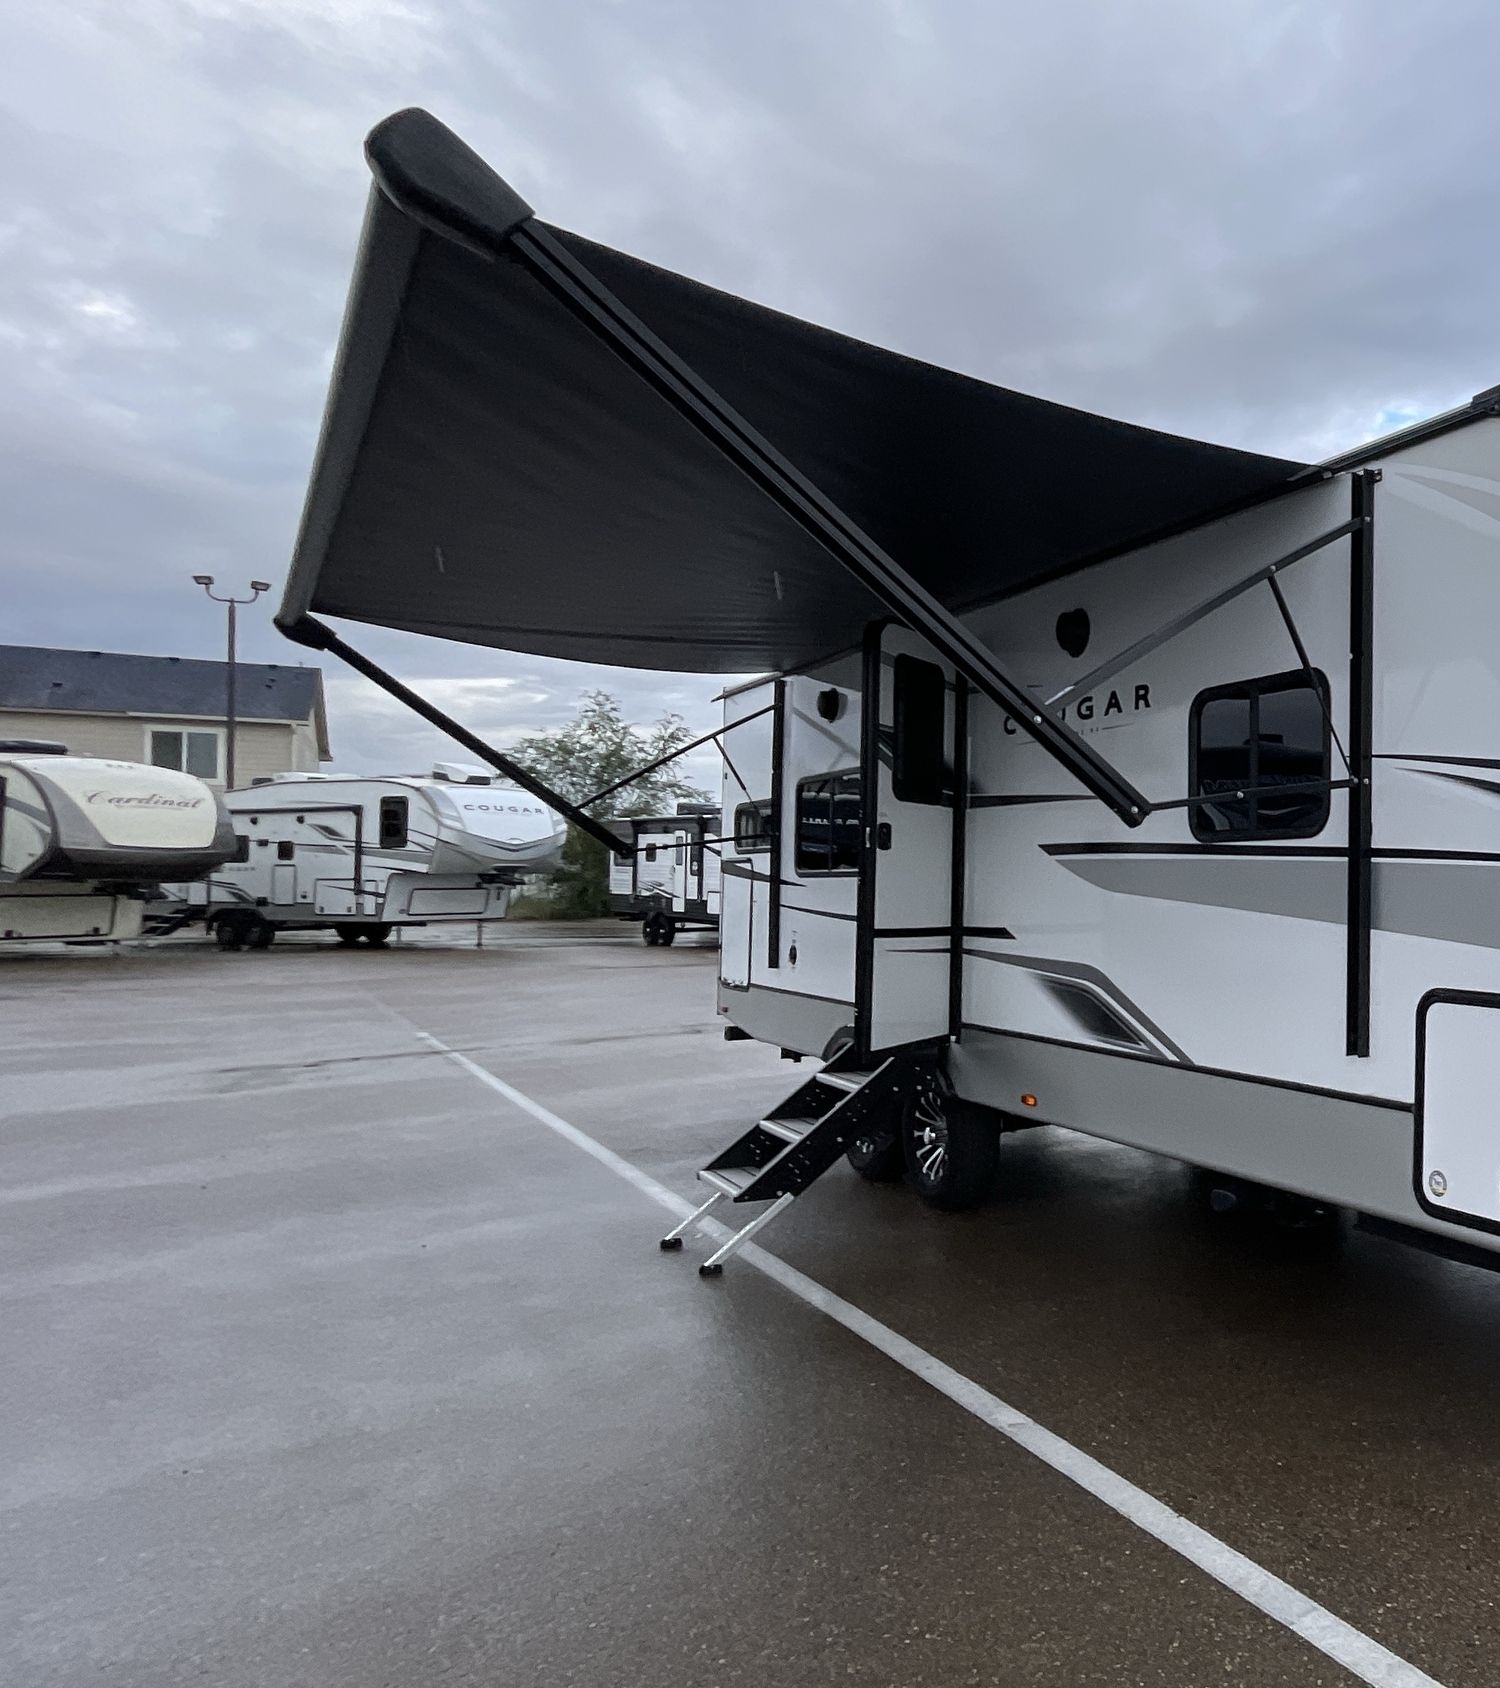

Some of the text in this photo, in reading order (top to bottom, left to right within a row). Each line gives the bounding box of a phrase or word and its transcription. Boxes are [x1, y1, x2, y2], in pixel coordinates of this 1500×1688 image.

[1003, 684, 1151, 735] CGAR
[85, 791, 206, 808] Cardinal
[463, 804, 544, 815] COUGAR
